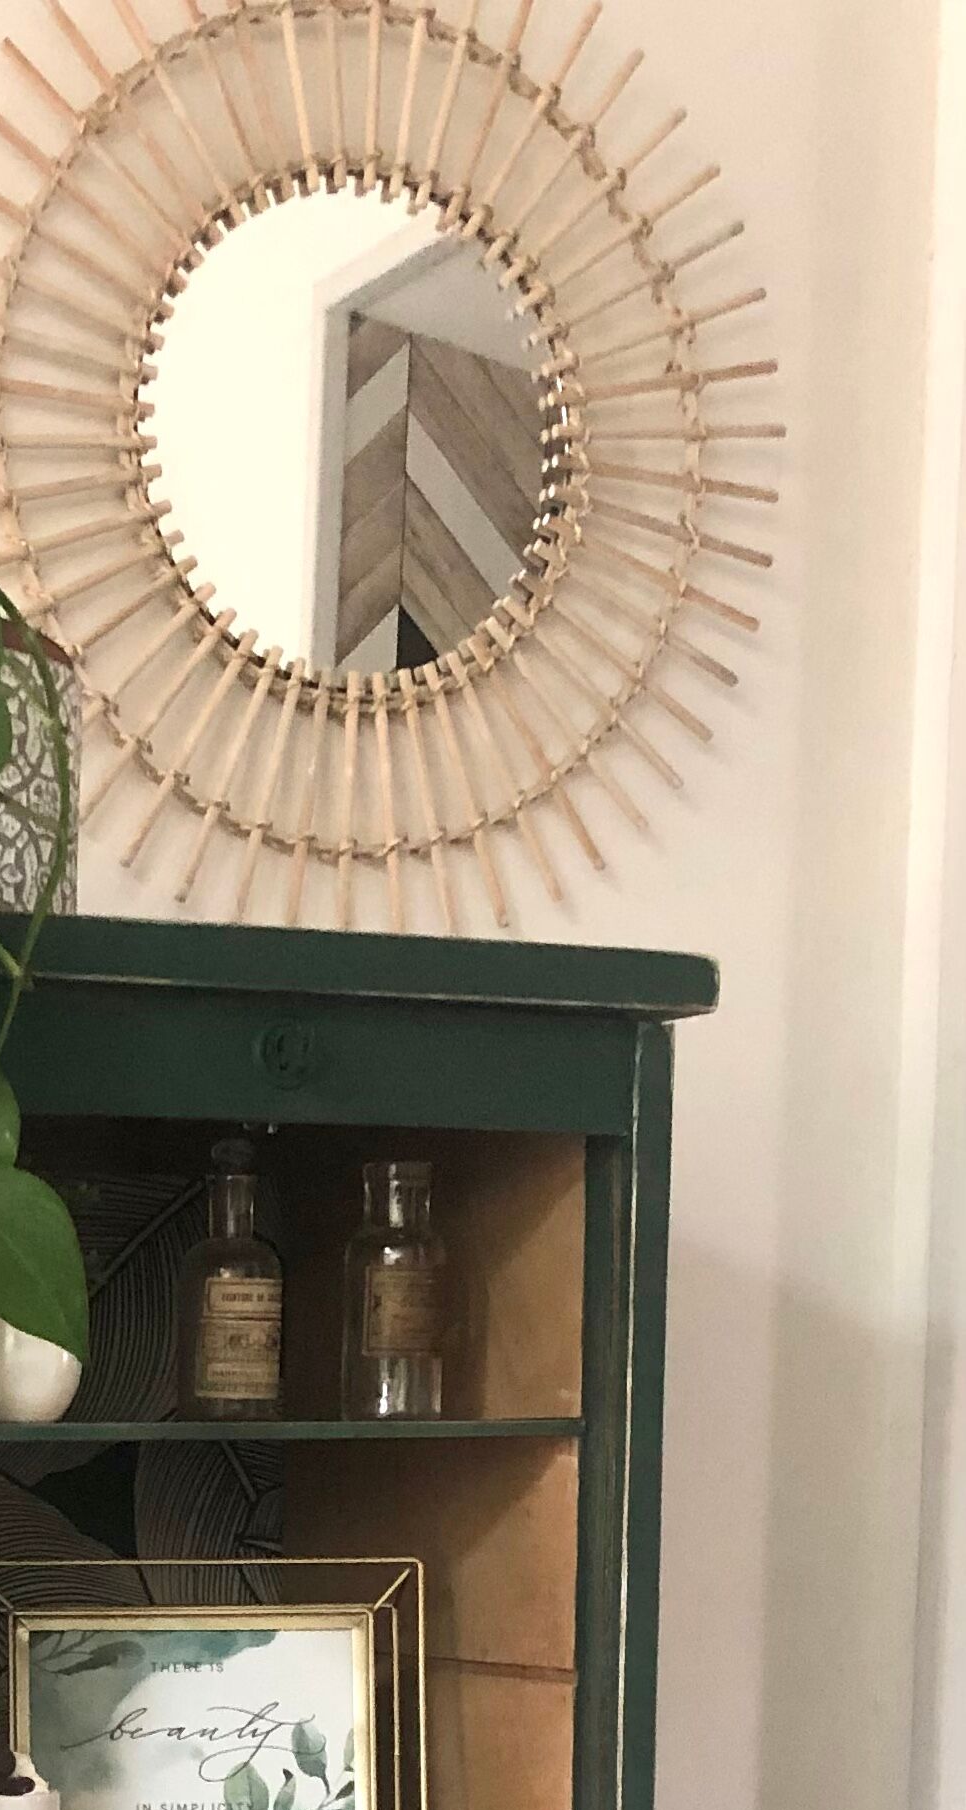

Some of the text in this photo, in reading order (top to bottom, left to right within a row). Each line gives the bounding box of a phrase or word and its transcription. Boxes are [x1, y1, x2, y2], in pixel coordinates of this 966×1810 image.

[151, 1662, 224, 1674] THERE IS
[59, 1701, 327, 1782] beauty
